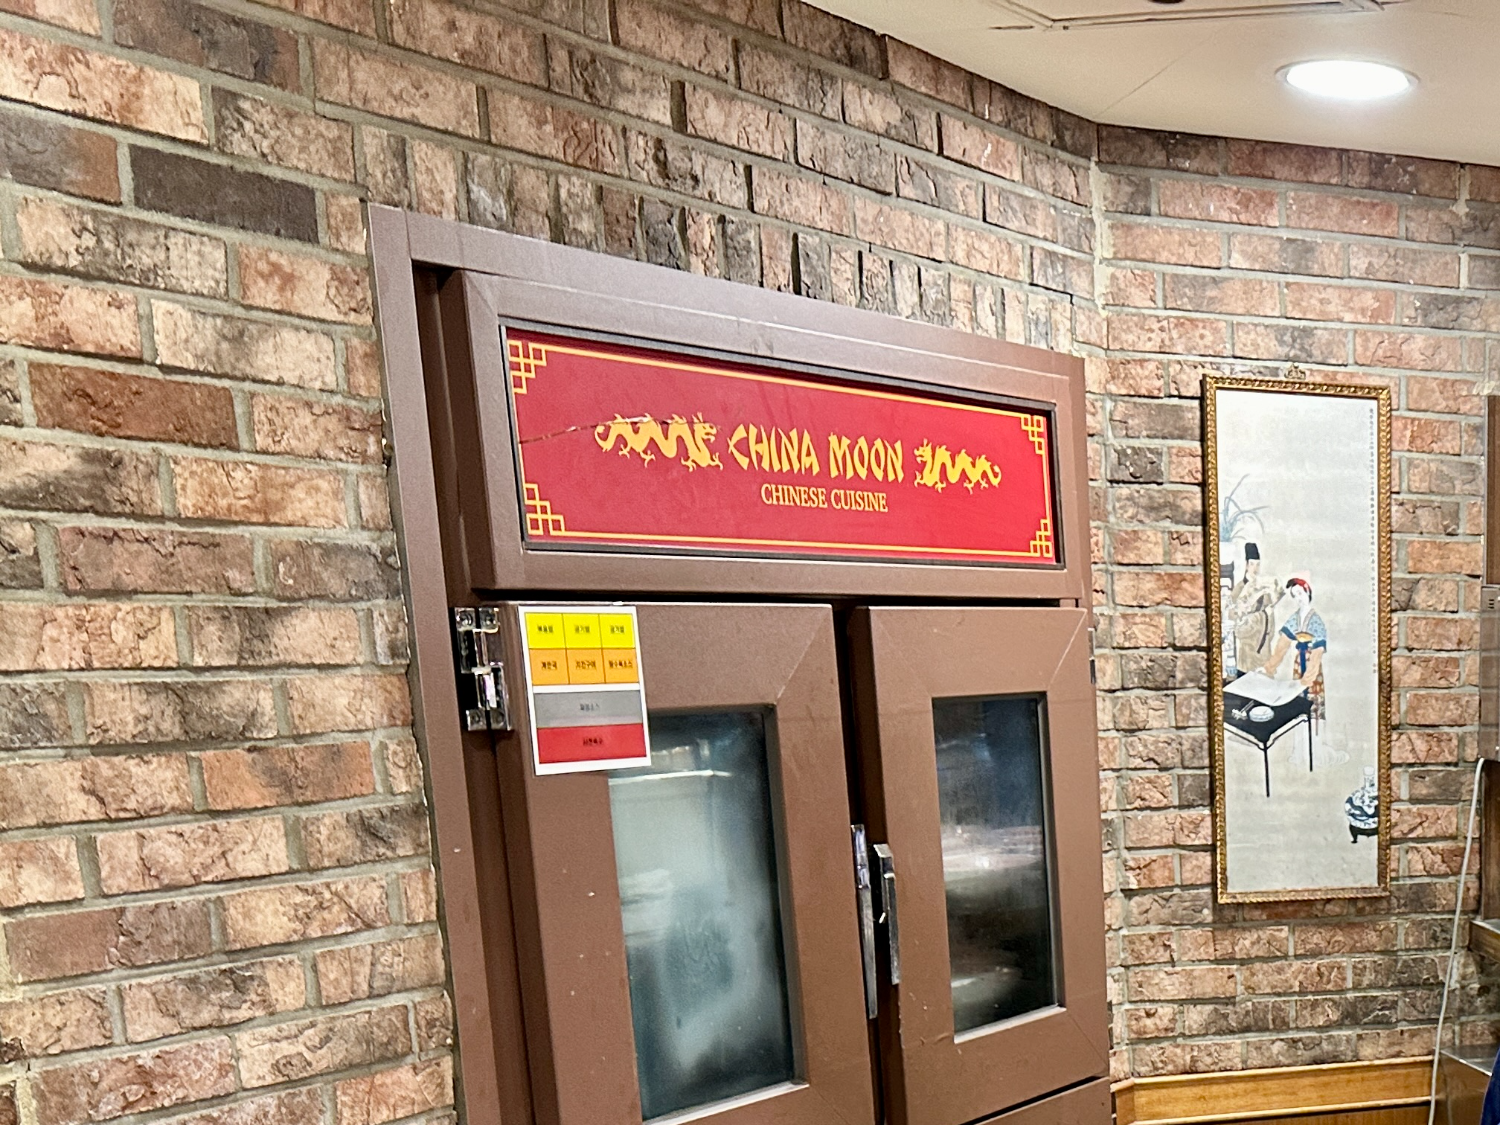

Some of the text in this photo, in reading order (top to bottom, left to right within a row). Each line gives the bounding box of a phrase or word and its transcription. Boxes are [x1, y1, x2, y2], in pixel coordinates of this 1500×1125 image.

[727, 423, 905, 484] CHINA MOON
[761, 483, 889, 513] CHINESE CUISINE
